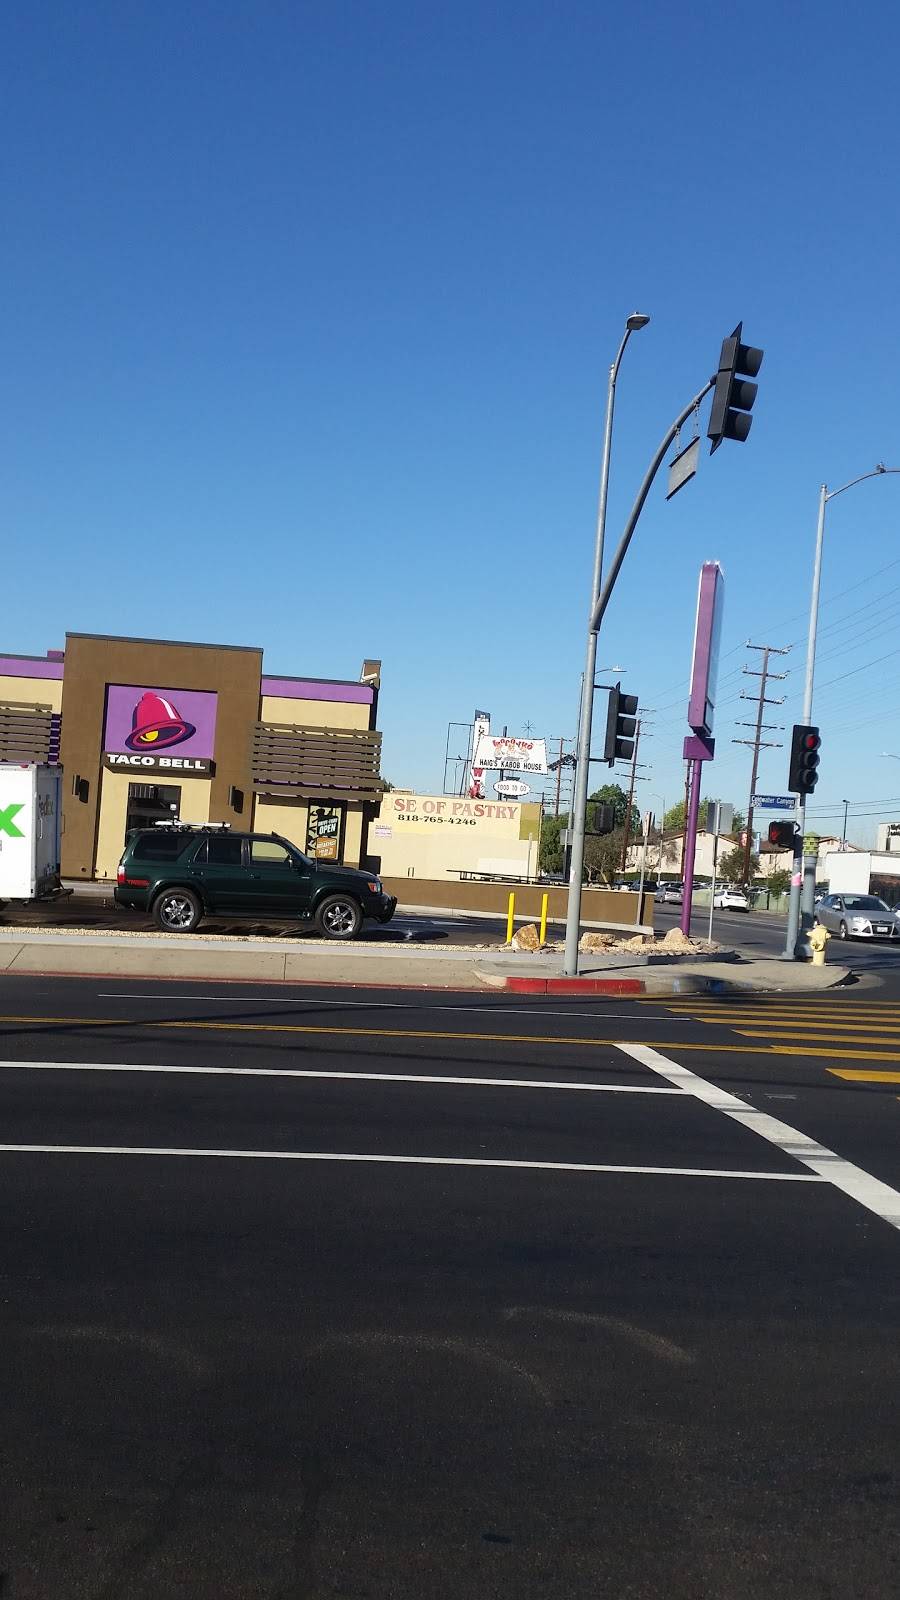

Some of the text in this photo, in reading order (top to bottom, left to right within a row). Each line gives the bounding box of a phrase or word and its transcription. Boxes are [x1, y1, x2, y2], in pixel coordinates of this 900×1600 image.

[107, 754, 206, 769] TACO BELL
[479, 758, 542, 771] HAIG'S KABOB HOUSE
[422, 800, 446, 815] OF
[451, 803, 519, 820] PASTRY
[397, 814, 477, 826] 818-765-4246
[319, 822, 337, 835] OPEN
